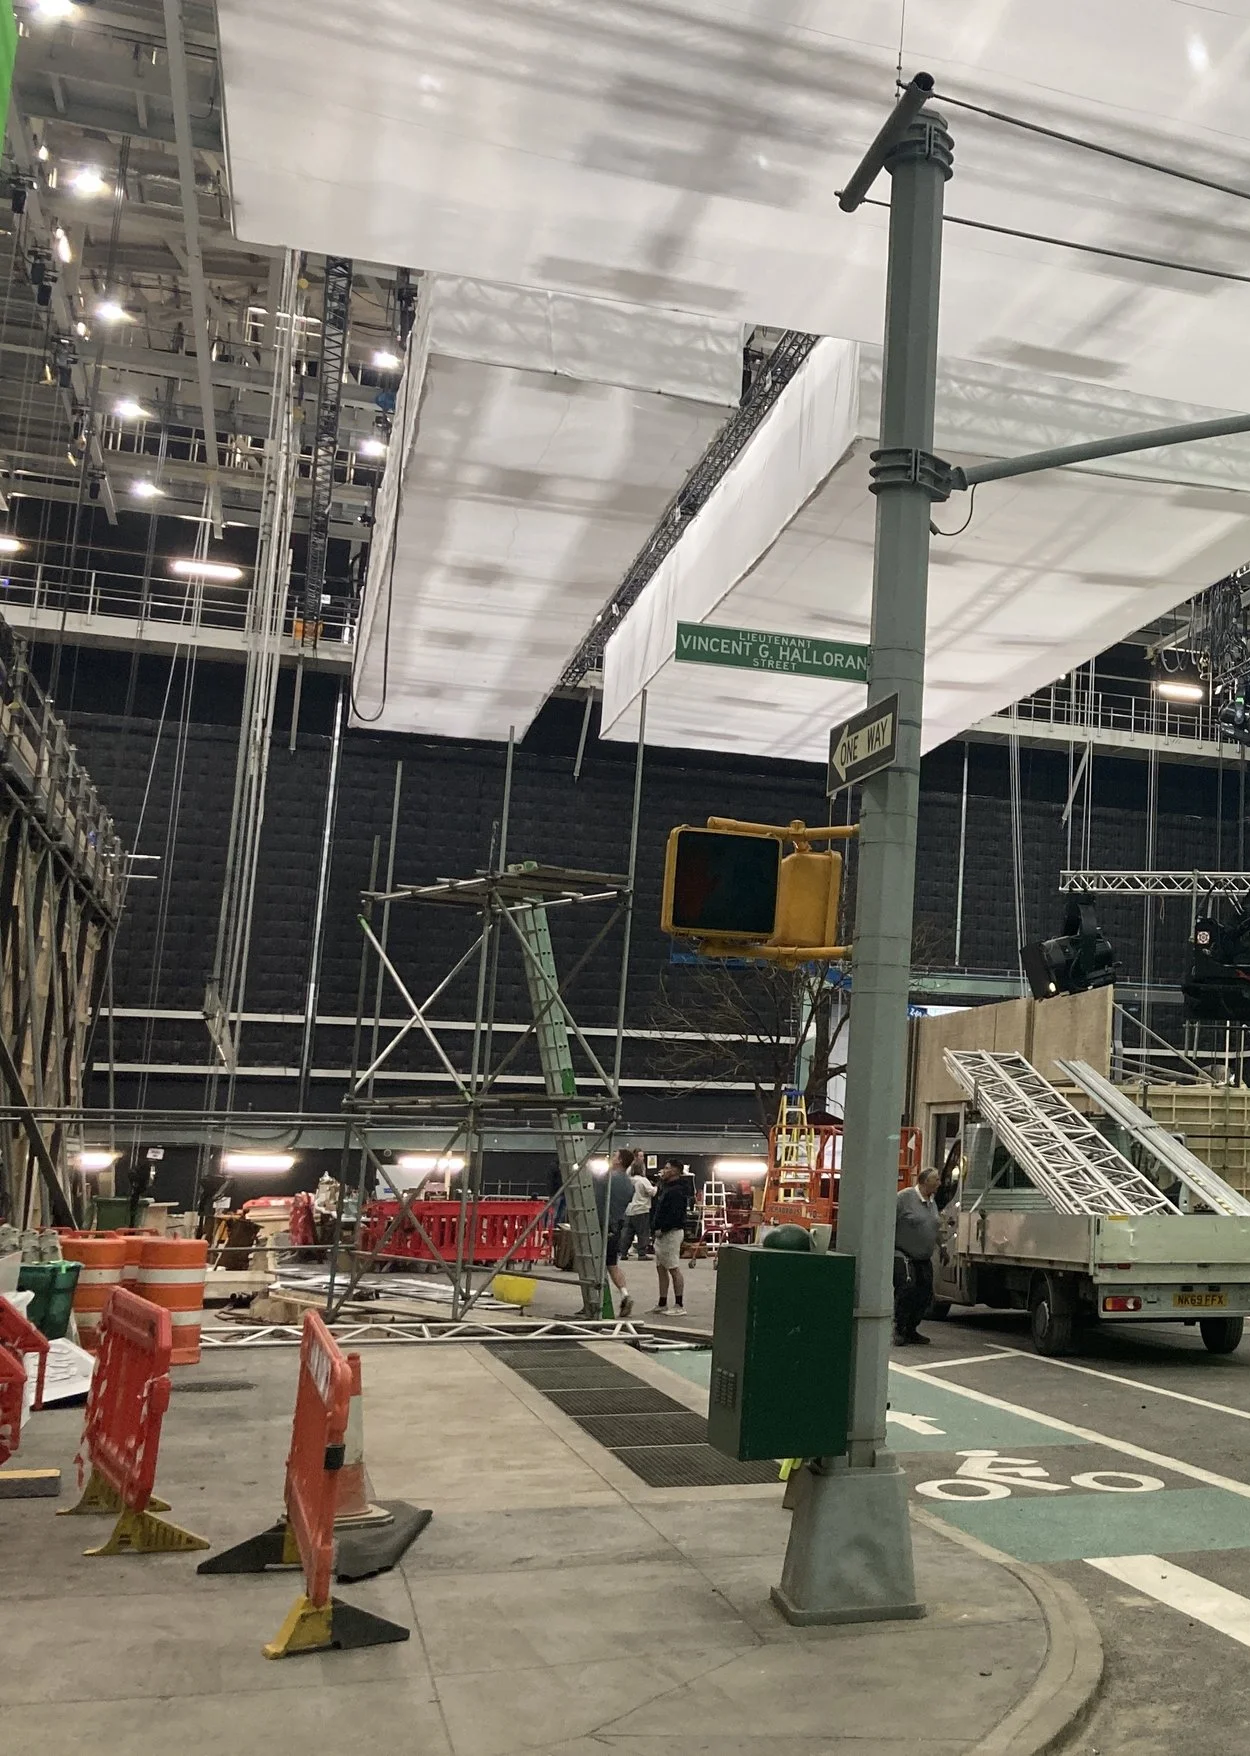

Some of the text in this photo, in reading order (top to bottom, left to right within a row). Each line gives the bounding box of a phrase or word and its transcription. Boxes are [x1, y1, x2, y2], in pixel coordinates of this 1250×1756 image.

[739, 632, 812, 648] LIEUTENANT
[680, 634, 868, 671] VINCENT G. HALLORAN
[752, 658, 798, 671] STREET
[840, 718, 888, 766] ONE WAY
[1177, 1295, 1224, 1305] NK69 FFX
